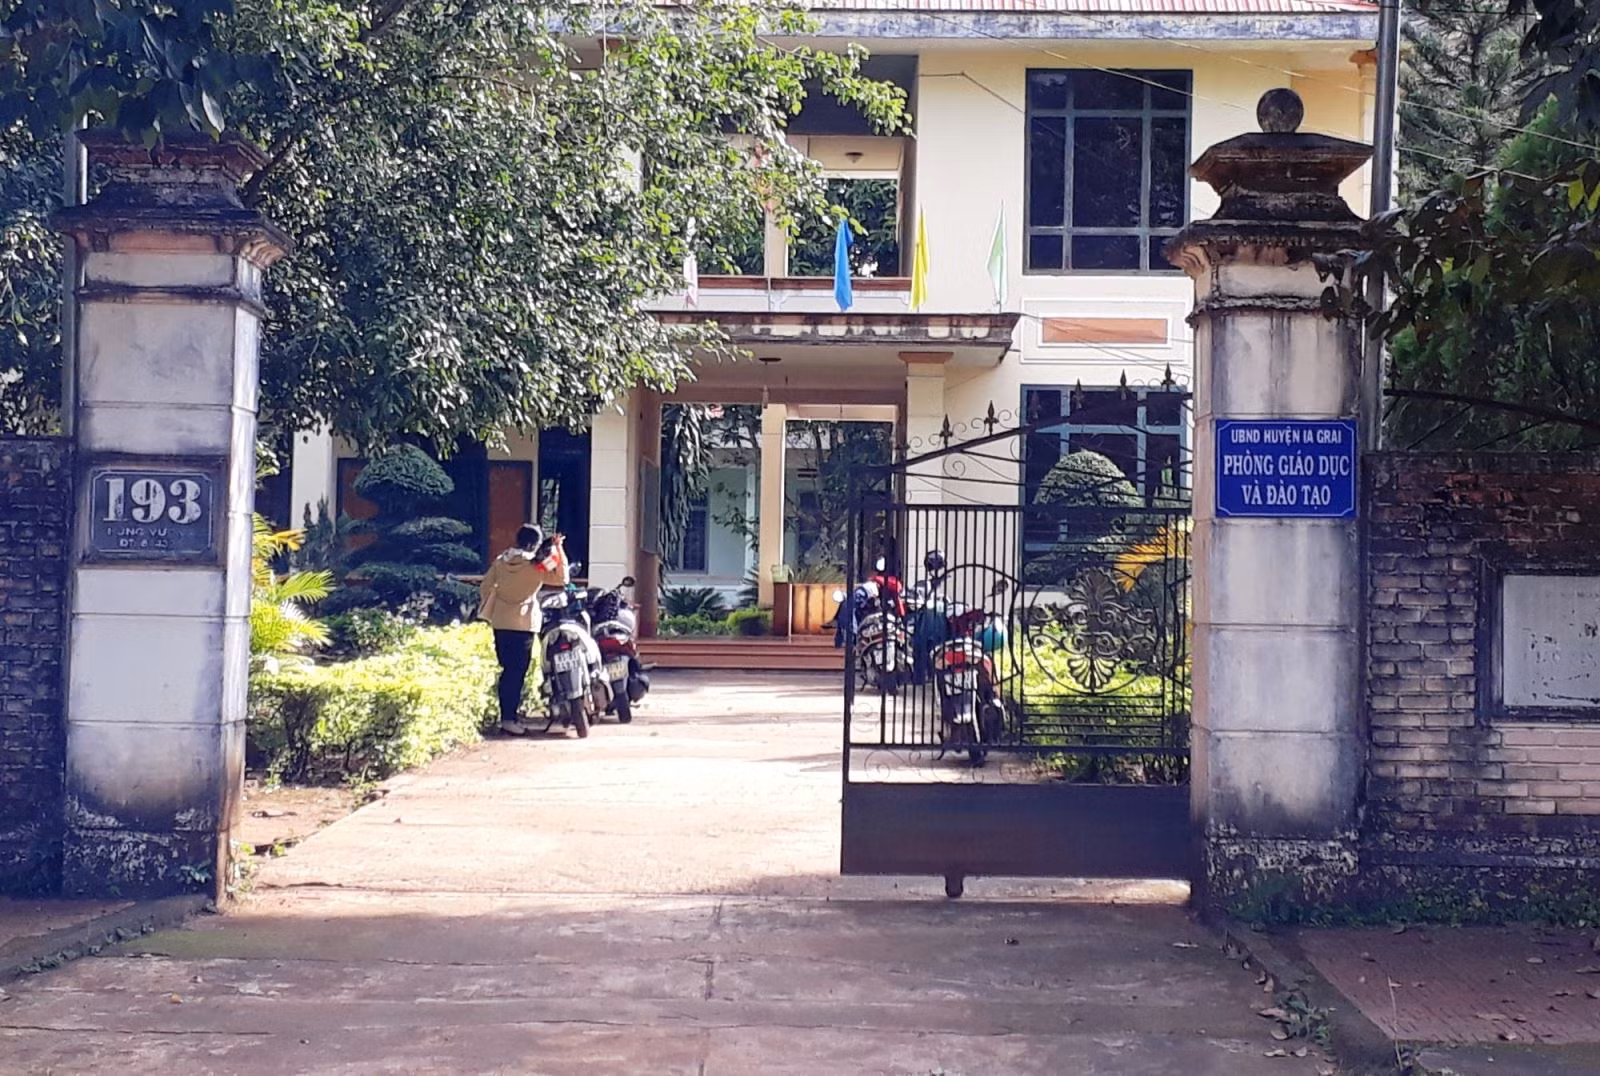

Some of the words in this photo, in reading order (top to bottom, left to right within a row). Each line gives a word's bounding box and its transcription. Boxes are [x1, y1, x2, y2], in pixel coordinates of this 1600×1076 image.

[1231, 429, 1261, 443] UBND
[1264, 425, 1300, 446] HUYỆN
[1303, 429, 1314, 443] IA
[1316, 429, 1342, 443] GRAI
[1223, 449, 1274, 476] PHÒNG
[1278, 449, 1315, 476] GIÁO
[1318, 455, 1350, 480] DỤC
[103, 478, 202, 524] 193
[1241, 479, 1263, 505] VÀ
[1266, 479, 1297, 506] ĐÀO
[1301, 485, 1331, 510] TẠO
